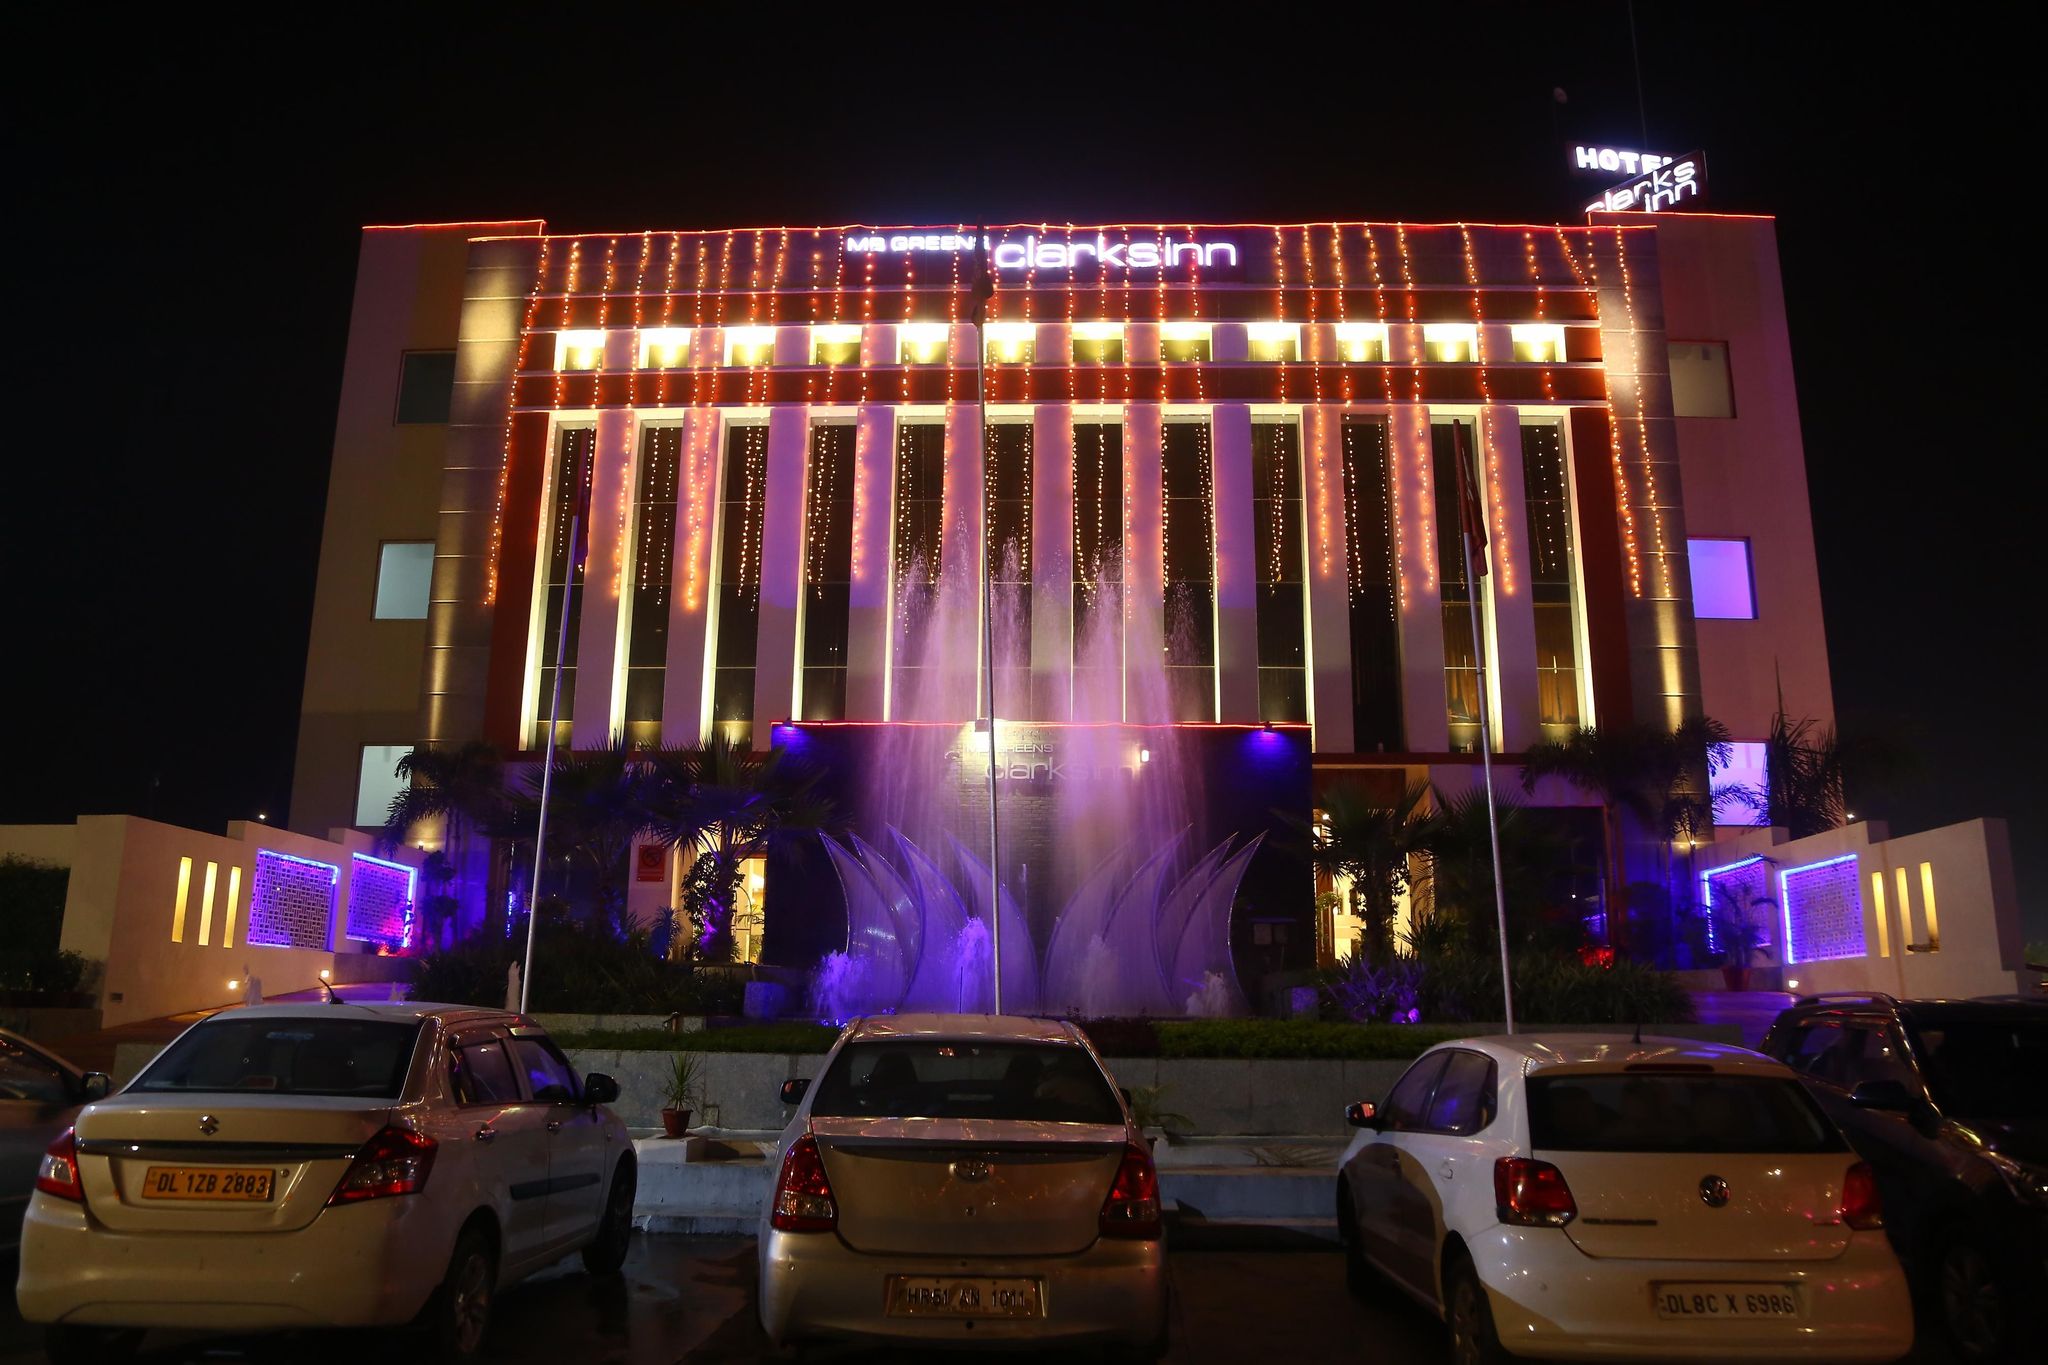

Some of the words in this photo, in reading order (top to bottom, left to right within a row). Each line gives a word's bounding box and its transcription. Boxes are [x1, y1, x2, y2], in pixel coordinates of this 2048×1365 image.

[1643, 179, 1697, 213] inn
[156, 1173, 178, 1193] DL
[221, 1174, 267, 1194] 2883
[959, 1287, 980, 1306] AN
[1666, 1294, 1719, 1314] DL8C
[1726, 1294, 1739, 1313] X
[1745, 1294, 1795, 1314] 6986
